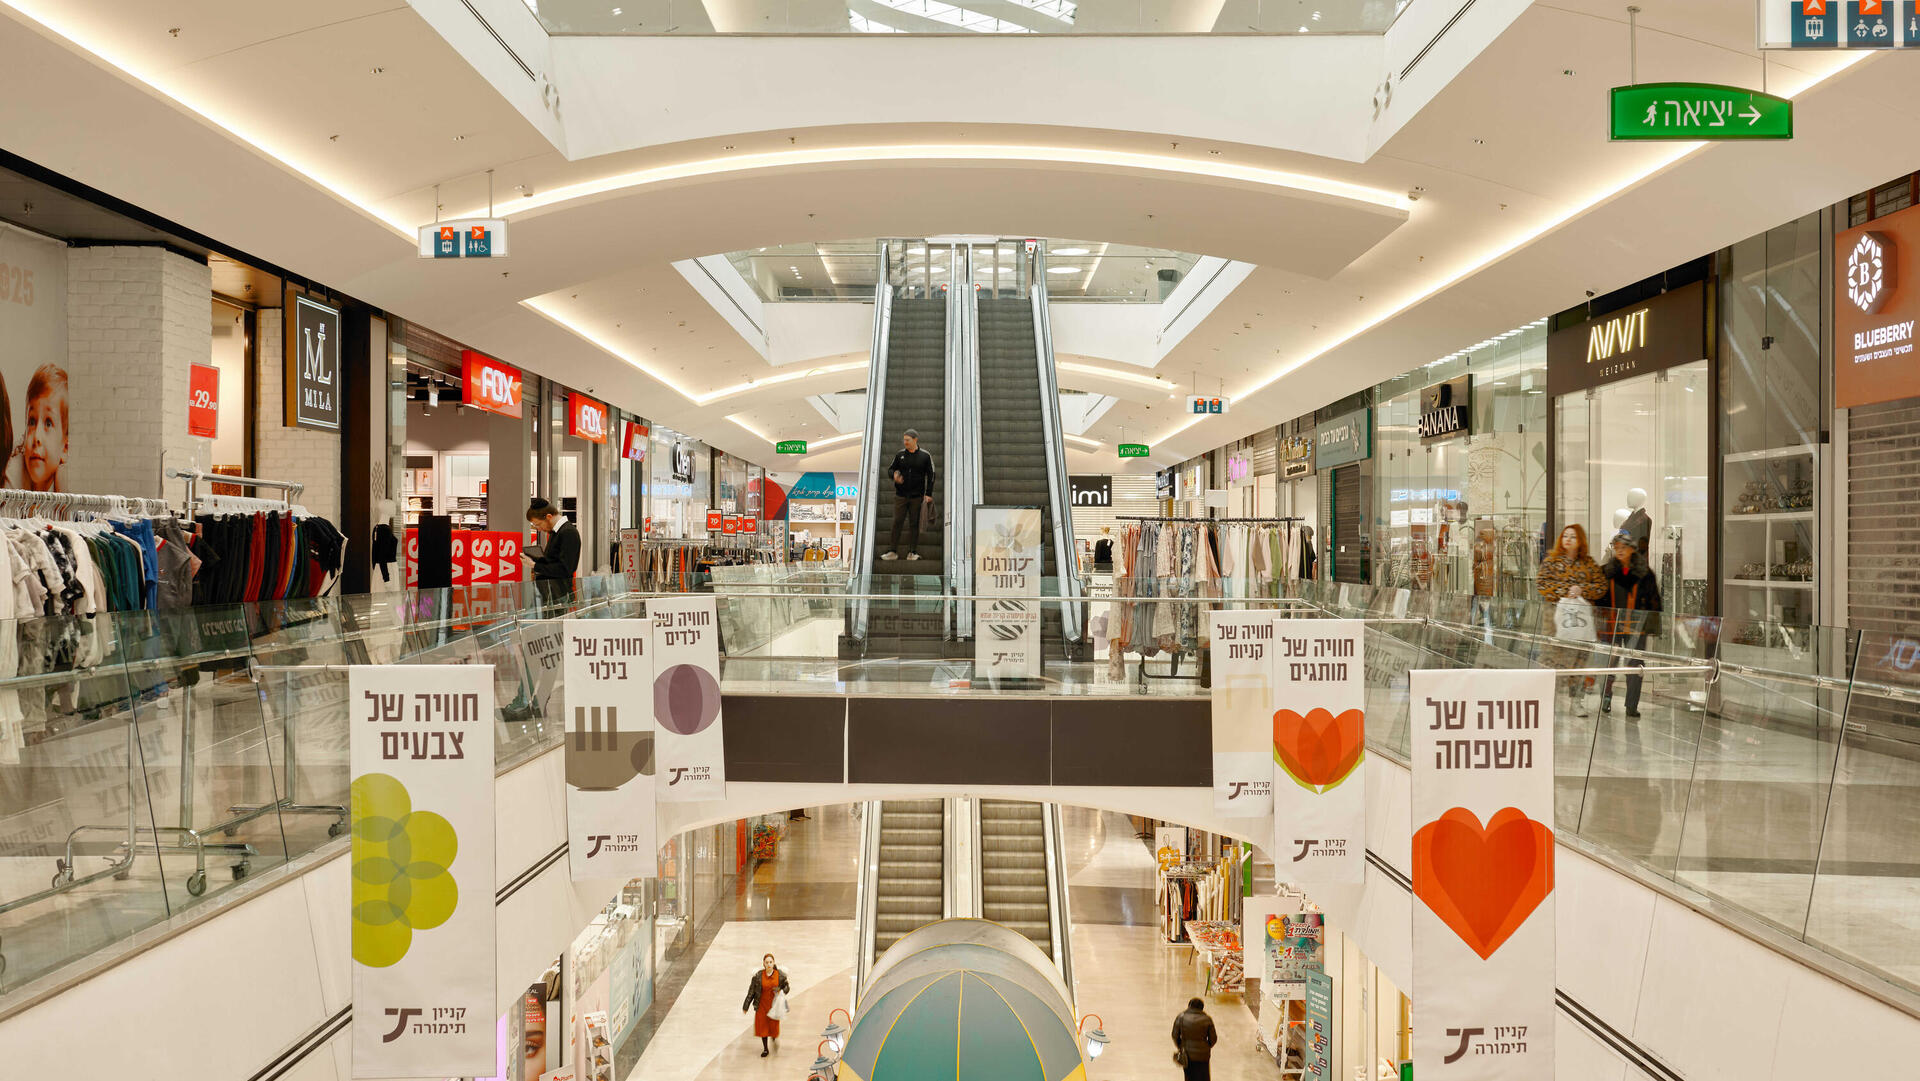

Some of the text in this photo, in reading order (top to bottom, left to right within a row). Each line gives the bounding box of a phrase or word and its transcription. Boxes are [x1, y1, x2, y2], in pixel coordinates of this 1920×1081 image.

[1664, 100, 1732, 126] יציאה
[1860, 262, 1870, 286] B
[1854, 320, 1914, 350] BLUEBERRY
[482, 366, 514, 406] FOX
[304, 388, 332, 411] MILA
[582, 404, 602, 436] FOX
[1417, 406, 1460, 438] BANANA
[1072, 484, 1108, 504] imi
[472, 538, 492, 618] SALE
[654, 611, 710, 628] חוויה של
[665, 629, 700, 646] ילדים
[1217, 624, 1272, 640] חוויה של
[572, 636, 643, 656] חוויה של
[1229, 644, 1263, 660] קניות
[1282, 636, 1354, 656] חוויה של
[589, 660, 628, 680] בילוי
[1290, 663, 1348, 681] מותגים
[364, 690, 478, 722] חוויה של
[1426, 697, 1539, 730] חוויה של
[380, 732, 464, 760] צבעים
[1436, 740, 1532, 770] משפחה
[684, 773, 710, 781] תימורה
[604, 844, 638, 852] תימורה
[616, 834, 638, 844] קניון
[1324, 840, 1346, 848] קניון
[1312, 848, 1346, 856] תימורה
[432, 1008, 466, 1020] קניון
[413, 1024, 466, 1034] תימורה
[1494, 1026, 1528, 1040] קניון
[1476, 1042, 1527, 1054] תימורה
